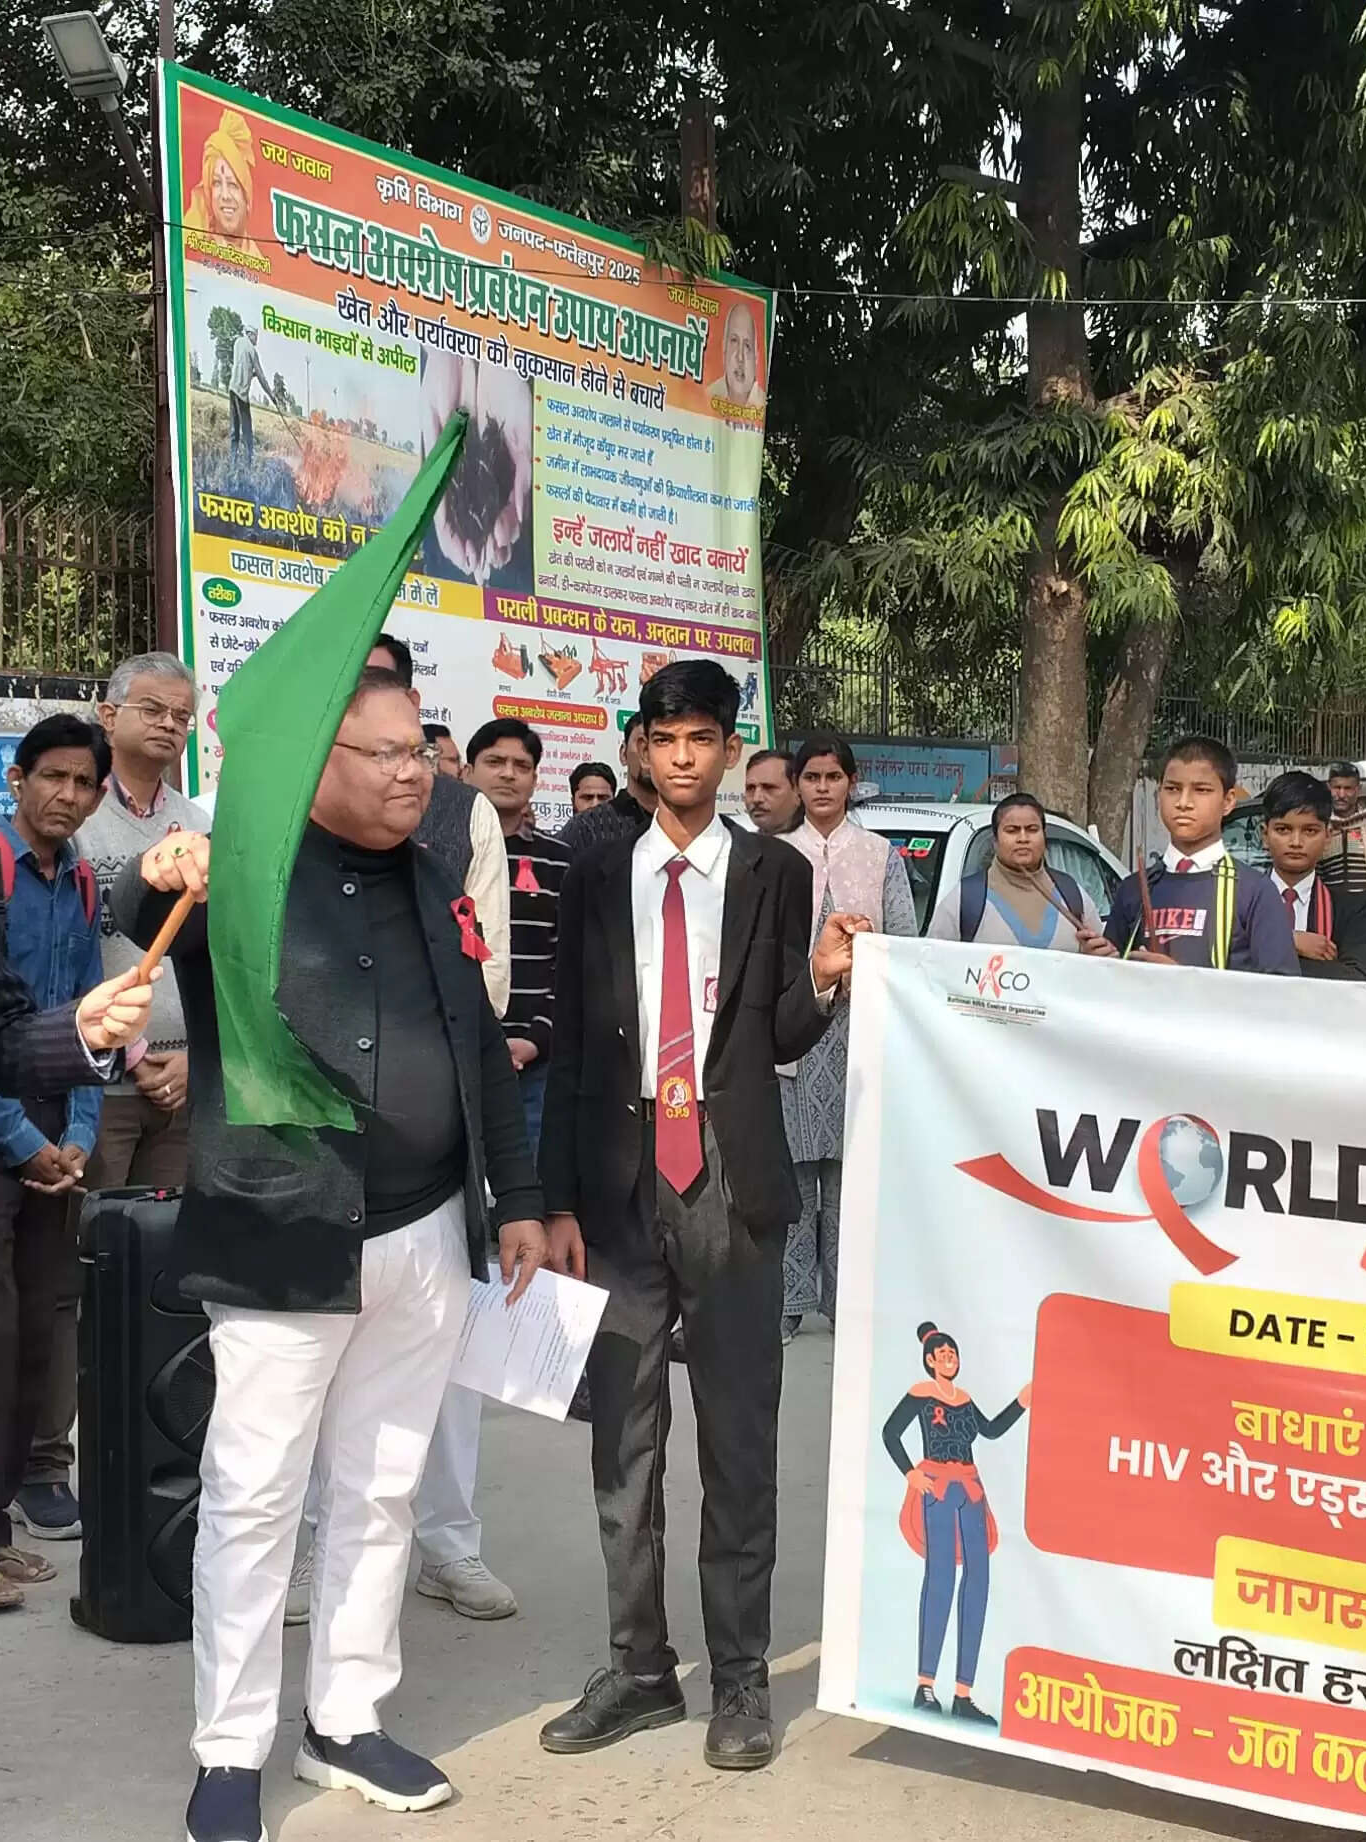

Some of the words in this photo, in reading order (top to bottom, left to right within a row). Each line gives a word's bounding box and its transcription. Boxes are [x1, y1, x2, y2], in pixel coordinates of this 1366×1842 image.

[260, 139, 288, 167] जय
[291, 151, 332, 183] जवान
[376, 174, 411, 205] कृषि
[414, 183, 463, 223] विभाग
[498, 219, 605, 277] जनपद-फतेहपुर
[609, 262, 642, 286] 2025
[271, 189, 364, 274] फसल
[365, 222, 465, 308] अवशेष
[465, 252, 551, 334] प्रबंधन
[552, 287, 618, 354] उपाय
[619, 307, 708, 382] अपनायें
[668, 285, 686, 305] जय
[687, 287, 719, 317] किसान
[262, 305, 312, 343] किसान
[315, 328, 359, 357] भाइयों
[361, 336, 373, 362] से
[377, 343, 418, 374] अपील
[337, 287, 371, 328] खेत
[378, 300, 409, 337] और
[414, 315, 483, 359] पर्यावरण
[487, 334, 508, 368] को
[514, 347, 575, 387] नुकसान
[581, 363, 608, 397] होने
[613, 371, 625, 401] से
[630, 382, 666, 412] बचायें
[546, 426, 563, 443] खेत
[563, 429, 572, 445] में
[547, 398, 570, 416] फसल
[571, 404, 597, 422] अवशेष
[624, 416, 631, 431] से
[686, 434, 703, 451] होता
[546, 455, 570, 474] जमीन
[571, 456, 580, 473] में
[653, 478, 665, 496] की
[573, 487, 583, 505] की
[198, 491, 254, 528] फसल
[258, 504, 318, 538] अवशेष
[323, 512, 346, 545] को
[350, 526, 366, 547] न
[552, 513, 586, 548] इन्हें
[587, 524, 635, 554] जलायें
[636, 529, 668, 563] नहीं
[669, 541, 702, 568] खाद
[706, 547, 750, 575] बनायें
[231, 551, 274, 578] फसल
[278, 557, 324, 587] अवशेष
[209, 611, 237, 627] फसल
[239, 614, 270, 631] अवशेष
[209, 633, 219, 649] से
[496, 596, 538, 623] पराली
[593, 607, 607, 633] के
[646, 622, 690, 649] अनुदान
[695, 630, 712, 649] पर
[210, 657, 225, 673] एवं
[1228, 1308, 1327, 1349] DATE
[1231, 1399, 1363, 1457] बाधाएं
[1107, 1436, 1190, 1482] HIV
[1201, 1441, 1278, 1500] और
[1173, 1635, 1310, 1694] लक्षित
[1014, 1671, 1181, 1748] आयोजक
[1227, 1716, 1302, 1775] जन
